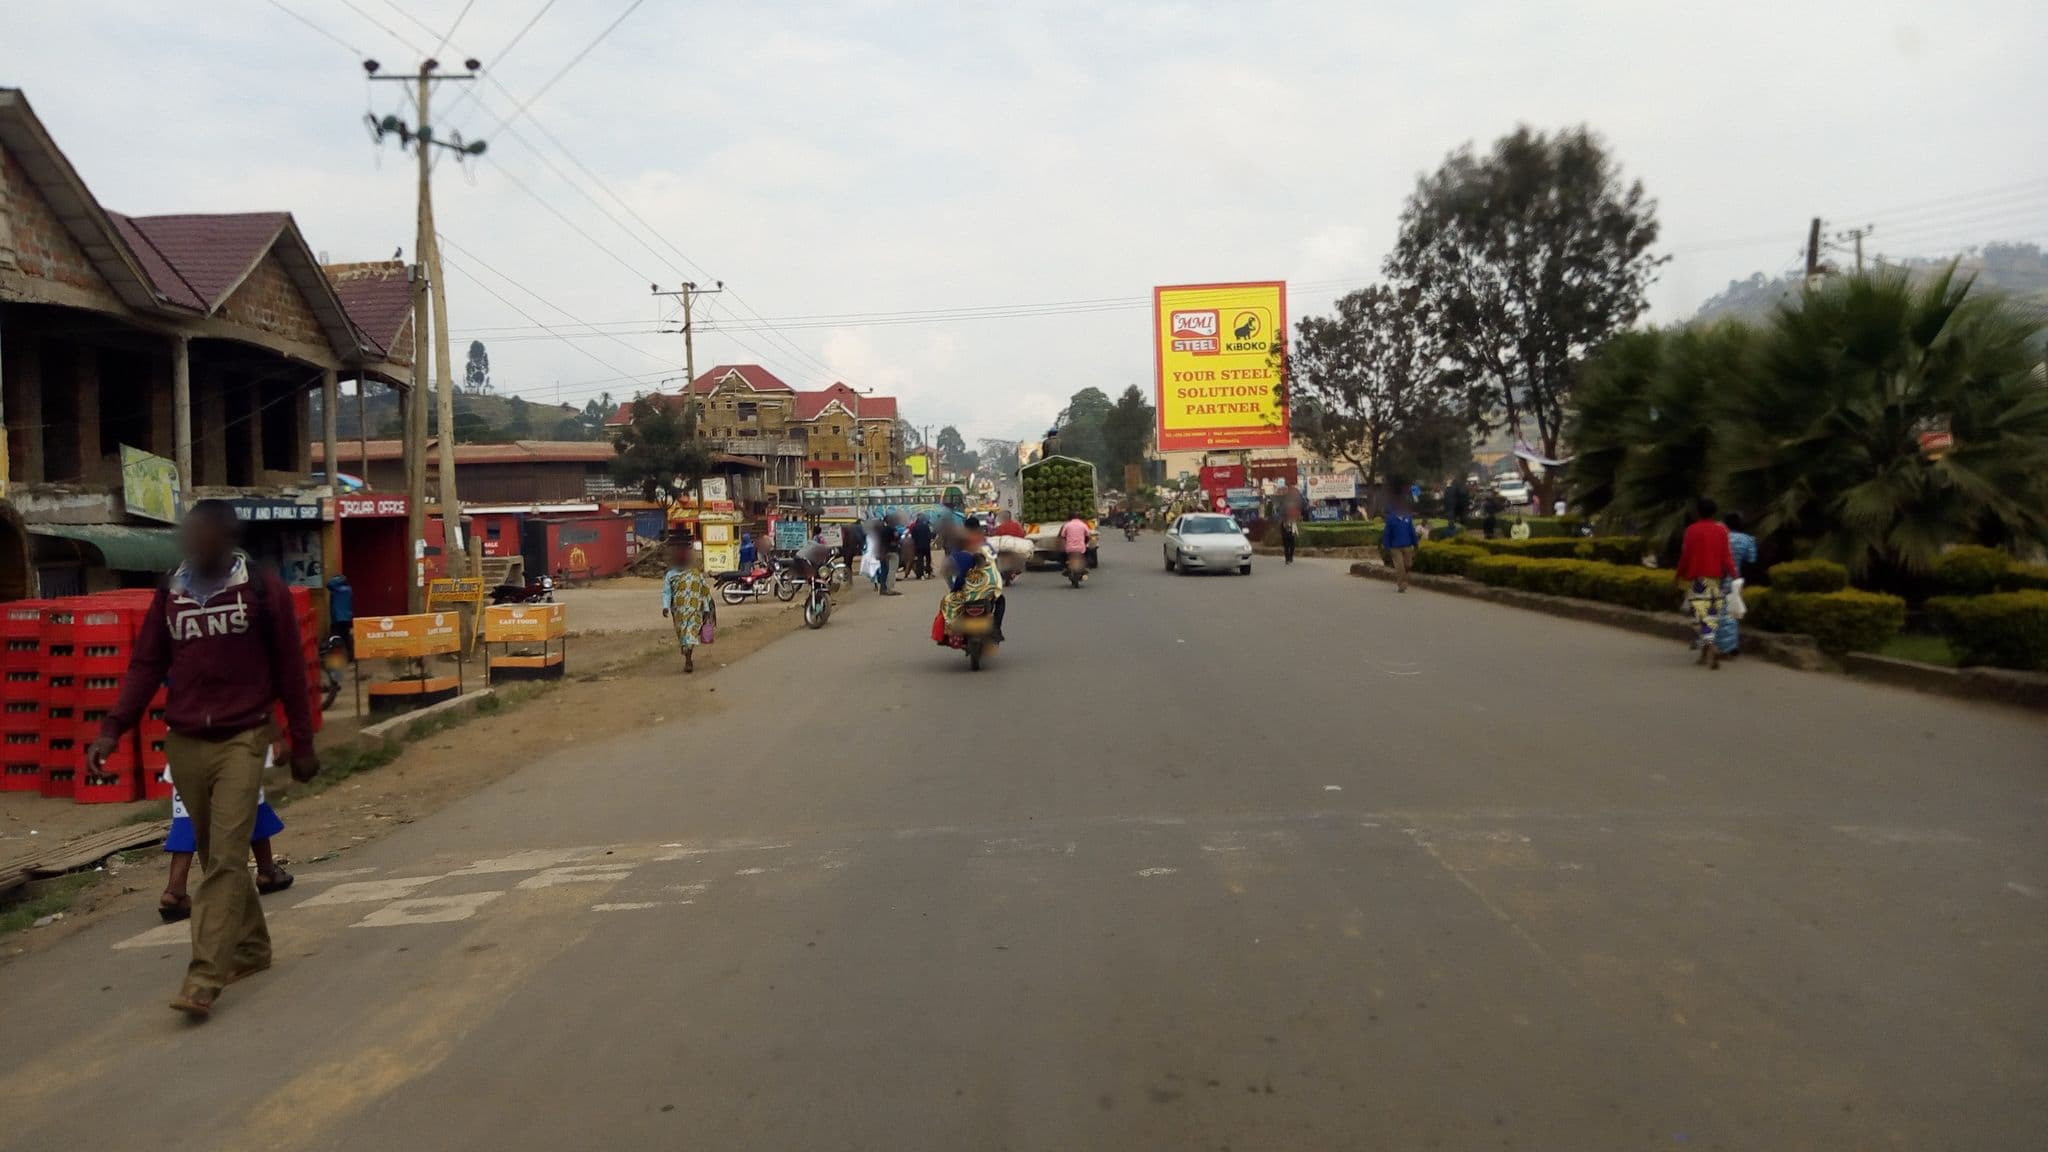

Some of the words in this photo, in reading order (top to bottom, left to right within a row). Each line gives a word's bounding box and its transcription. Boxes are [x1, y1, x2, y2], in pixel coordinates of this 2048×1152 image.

[1178, 316, 1213, 329] MMI
[1175, 340, 1216, 351] STEEL
[1173, 371, 1216, 382] YOUR
[1221, 369, 1272, 380] STEEL
[1177, 385, 1268, 398] SOLUTIONS
[1186, 402, 1260, 415] PARTNER
[255, 507, 271, 519] AND
[273, 507, 298, 519] FAMILY
[301, 507, 319, 518] SHOP
[167, 604, 249, 640] VANS
